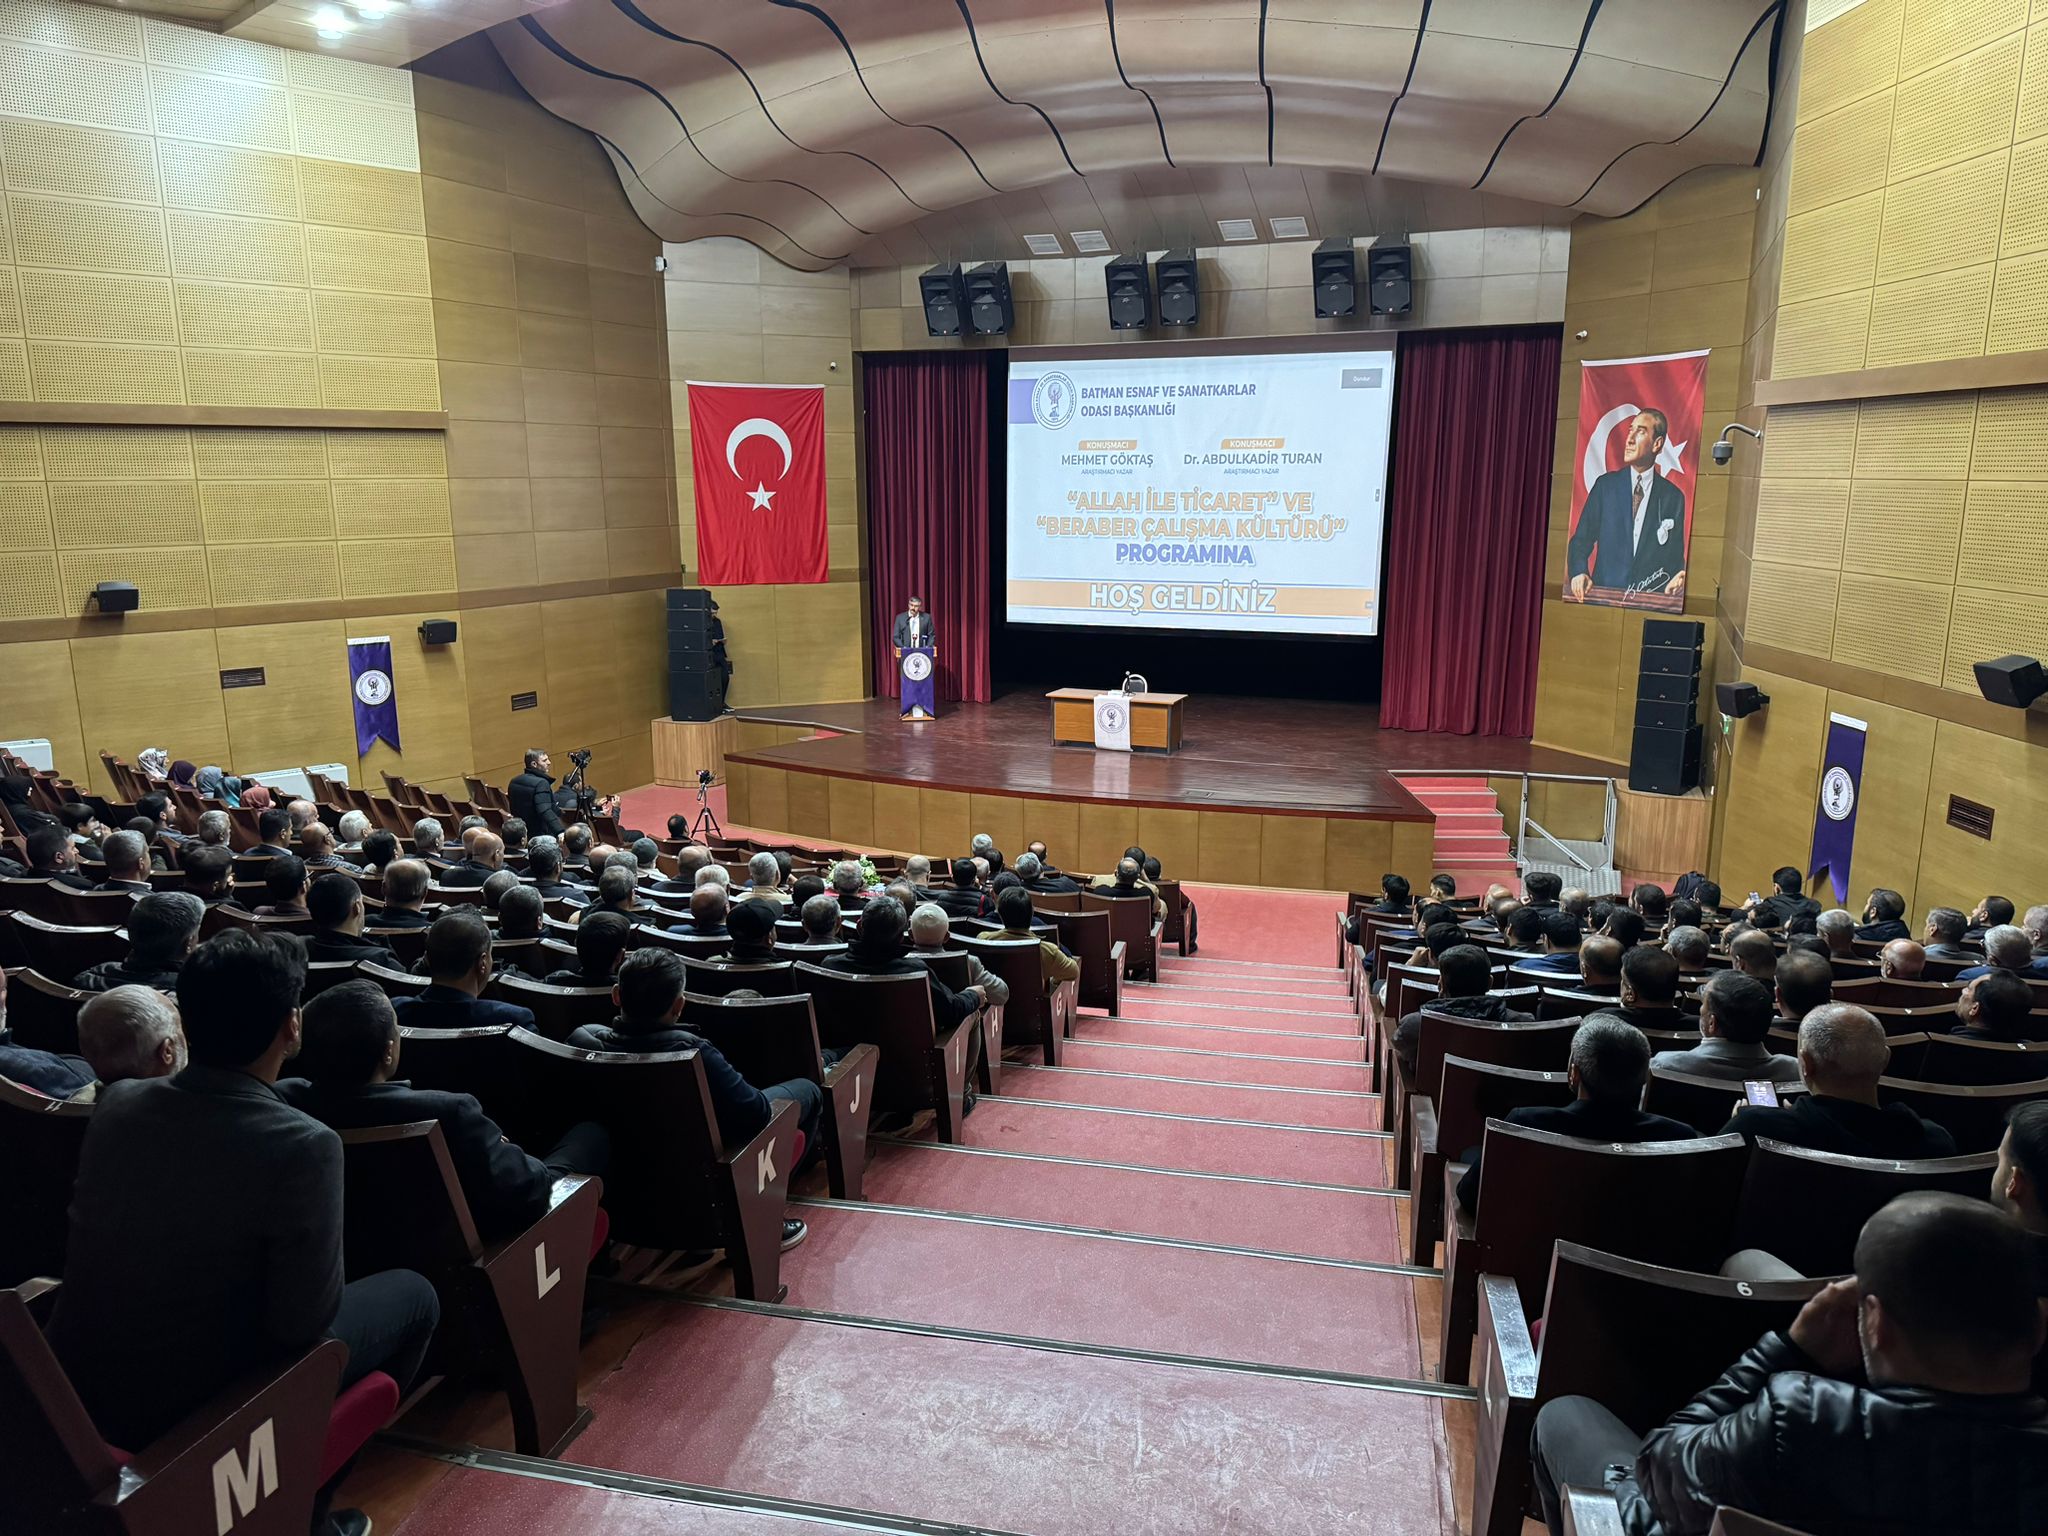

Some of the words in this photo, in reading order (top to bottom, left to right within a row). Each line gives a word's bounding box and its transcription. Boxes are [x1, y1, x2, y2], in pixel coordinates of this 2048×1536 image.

[1081, 387, 1124, 399] BATMAN
[1126, 386, 1160, 398] ESNAF
[1162, 385, 1176, 397] VE
[1178, 384, 1257, 396] SANATKARLAR
[1081, 405, 1112, 417] ODASI
[1114, 402, 1176, 418] BAŞKANLIĞI
[1086, 441, 1129, 450] KONUŞMACI
[1229, 439, 1276, 449] KONUŞMACI
[1061, 454, 1108, 466] MEHMET
[1110, 452, 1154, 468] GÖKTAŞ
[1183, 454, 1200, 465] Dr.
[1202, 451, 1279, 465] ABDULKADİR
[1281, 453, 1322, 464] TURAN
[1223, 468, 1260, 476] ARAŞTIRMACI
[1146, 487, 1176, 511] İLE
[1283, 491, 1312, 512] VE
[1141, 516, 1231, 542] ÇALIŞMA
[1115, 543, 1254, 564] PROGRAMINA
[1090, 583, 1145, 616] HOŞ
[1150, 579, 1277, 613] GELDİNİZ
[1056, 991, 1063, 1016] G
[991, 1006, 998, 1038] H
[849, 1074, 861, 1114] J
[1612, 1142, 1624, 1153] 8
[757, 1136, 777, 1195] K
[535, 1241, 561, 1300] L
[212, 1417, 279, 1536] M
